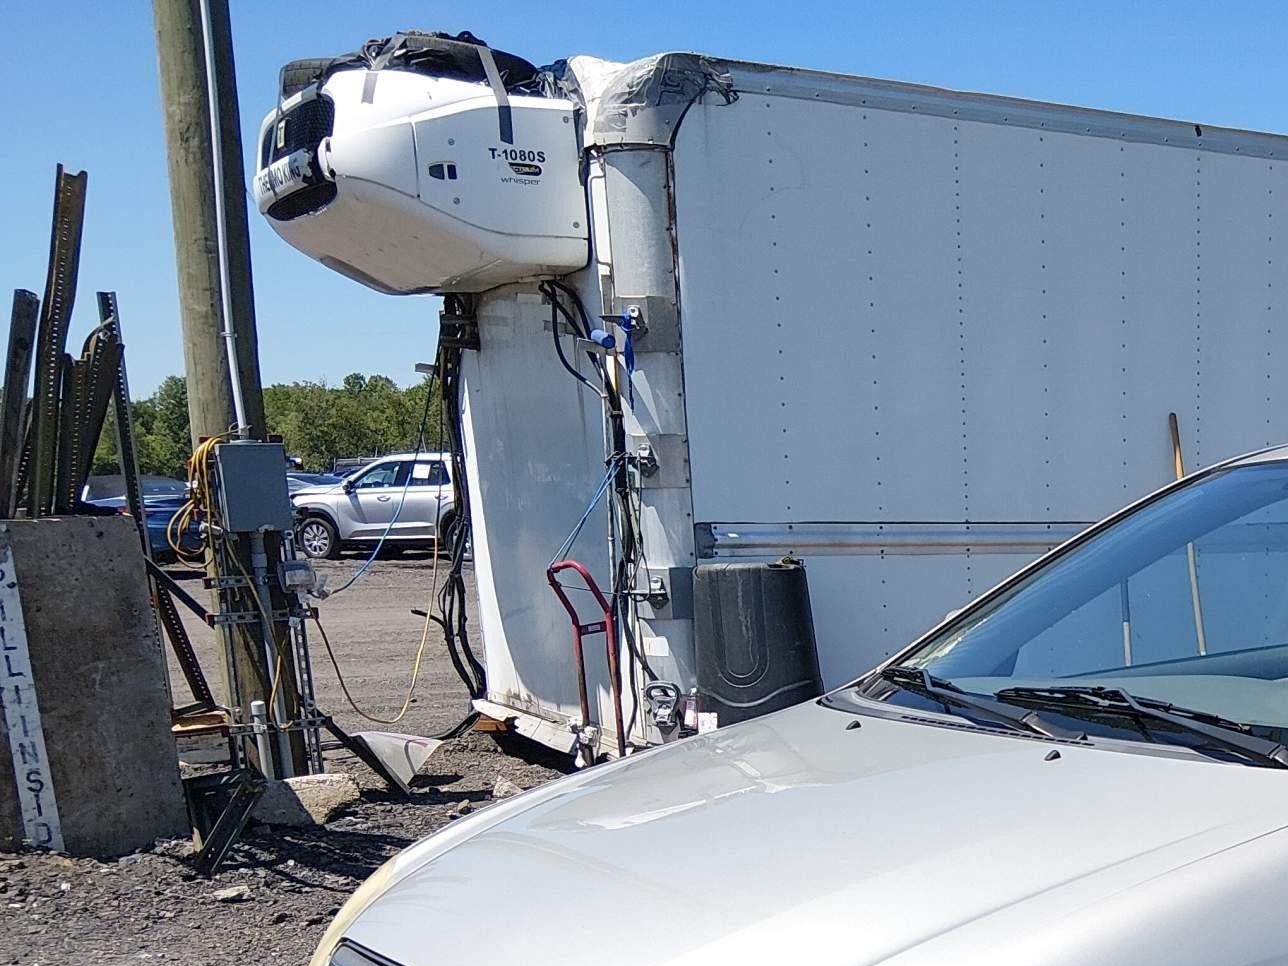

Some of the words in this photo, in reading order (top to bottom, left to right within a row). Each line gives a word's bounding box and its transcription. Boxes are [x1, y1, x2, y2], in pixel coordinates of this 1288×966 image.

[488, 147, 546, 163] T-1080S
[258, 167, 284, 195] THEMO
[501, 177, 541, 186] whisper
